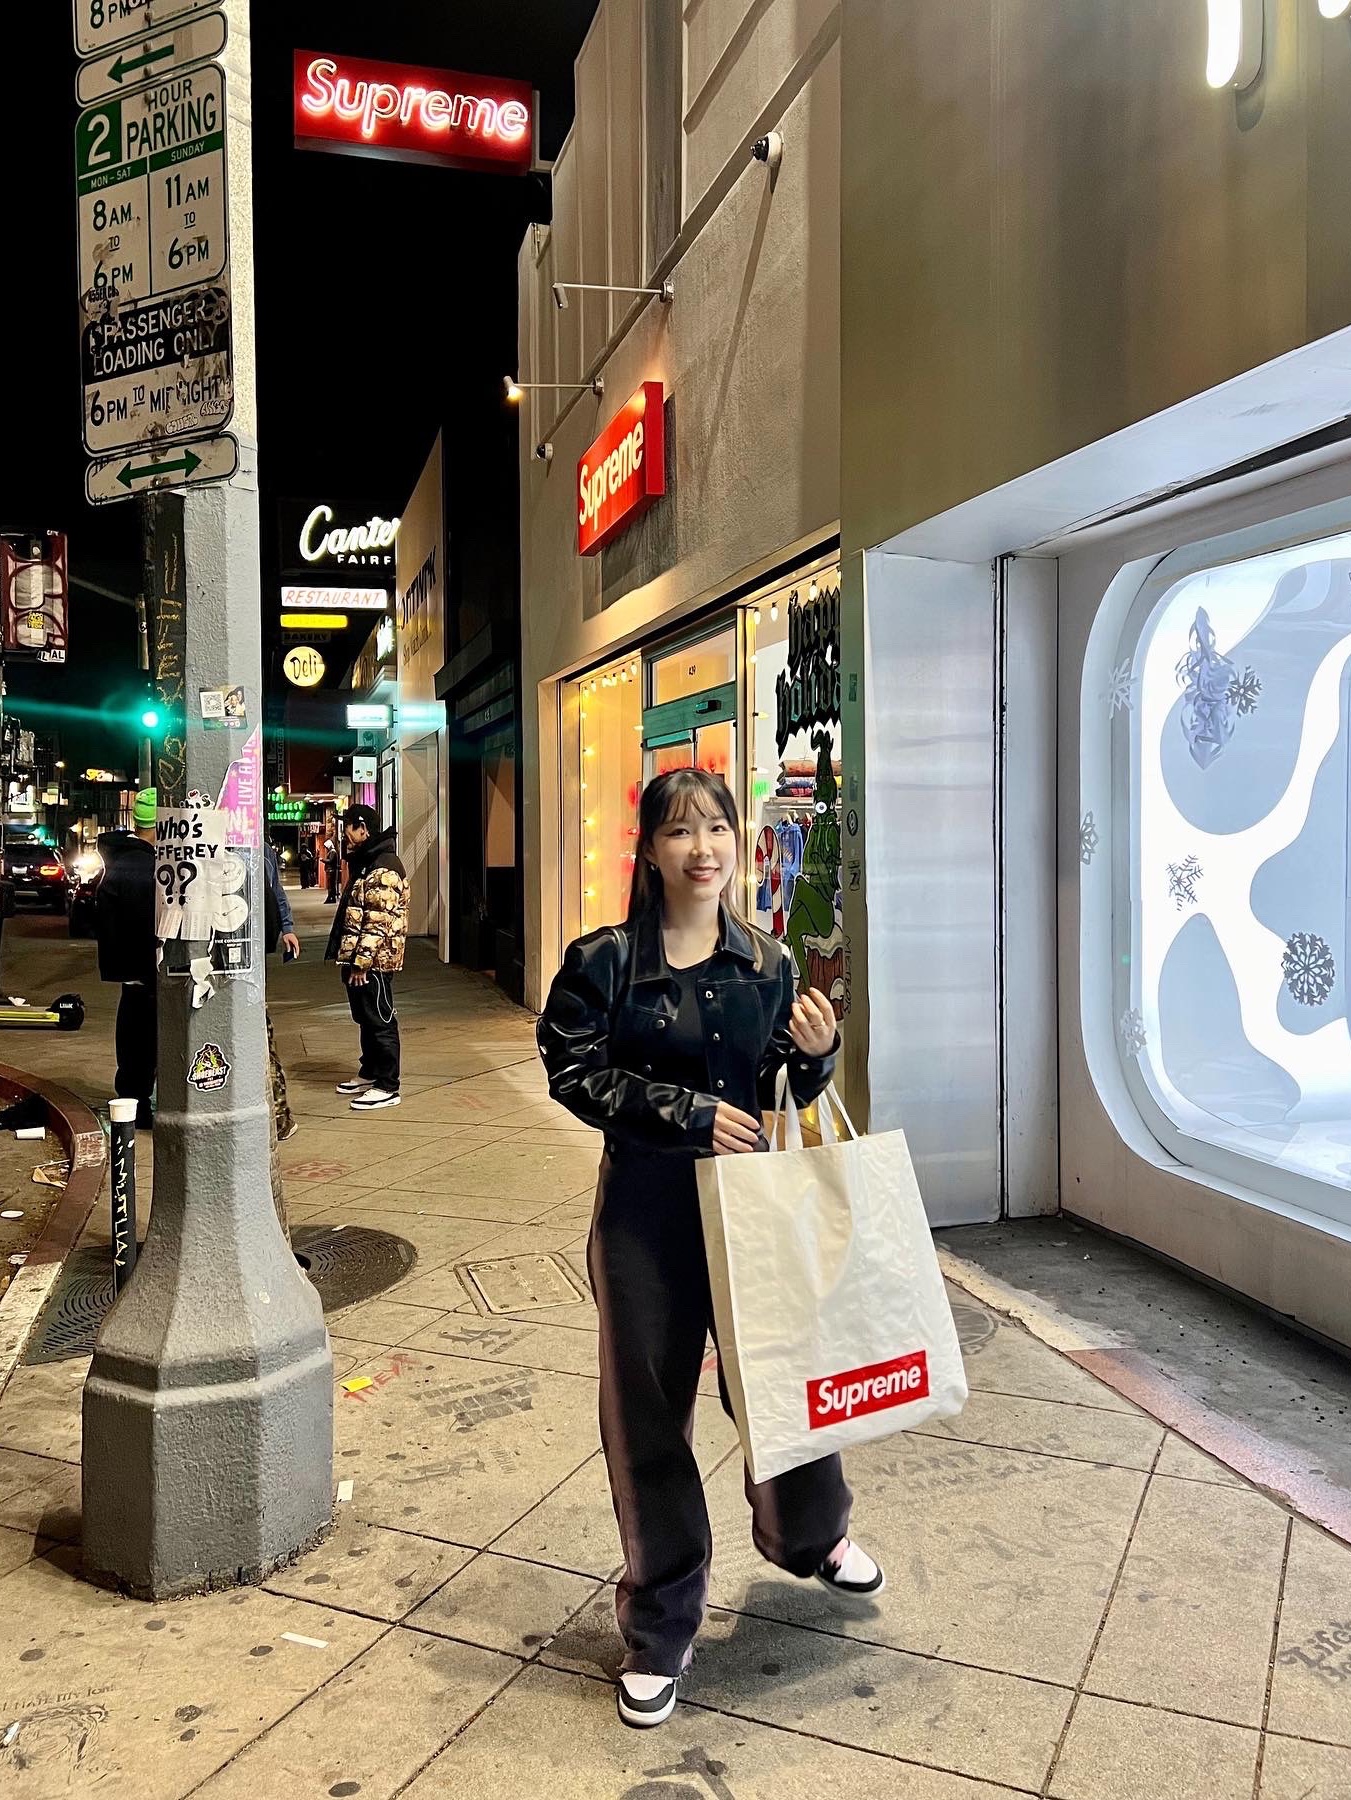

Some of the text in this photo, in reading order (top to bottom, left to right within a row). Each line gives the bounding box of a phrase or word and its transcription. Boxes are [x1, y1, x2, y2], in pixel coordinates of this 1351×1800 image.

[147, 78, 192, 113] HOUR
[302, 58, 529, 140] Supreme
[87, 113, 111, 167] 2
[126, 92, 217, 160] PARKING
[170, 142, 205, 162] SUNDAY
[184, 211, 196, 226] TO
[108, 235, 120, 250] TO
[104, 299, 206, 346] PASSENGER
[94, 324, 218, 376] LOADING ONLY
[132, 384, 146, 402] TO
[579, 421, 644, 531] Supreme
[284, 590, 382, 606] RESTAURANT
[289, 652, 318, 680] Deli
[238, 777, 253, 806] LIVE
[816, 1365, 922, 1416] Supreme
